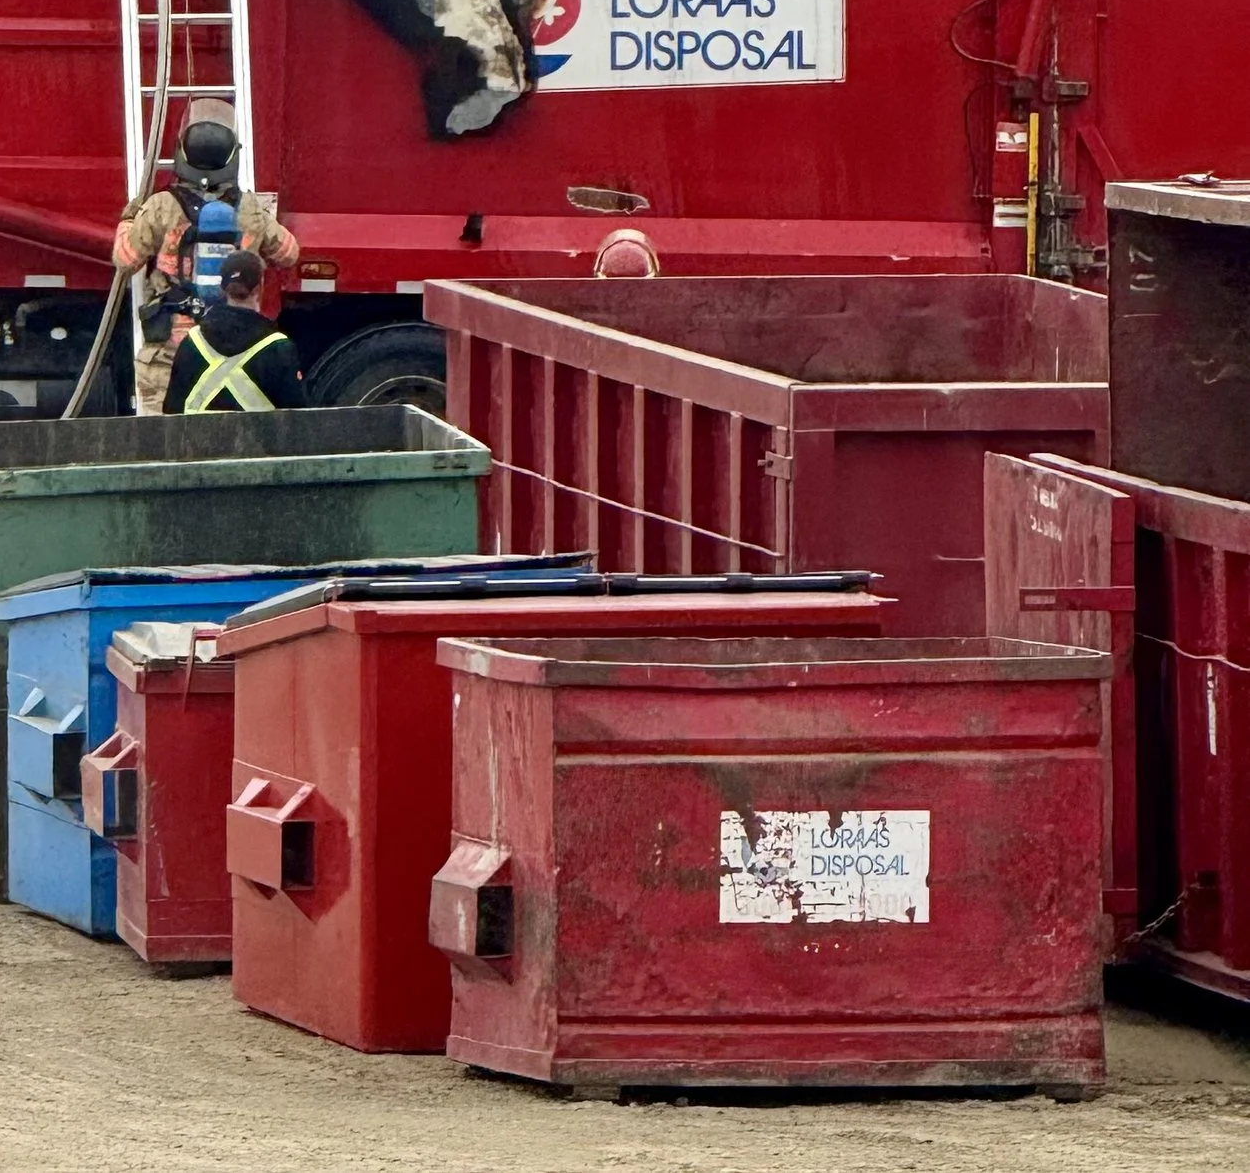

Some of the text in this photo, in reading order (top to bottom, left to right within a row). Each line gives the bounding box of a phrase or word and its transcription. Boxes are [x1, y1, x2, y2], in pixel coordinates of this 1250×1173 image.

[610, 29, 817, 71] DISPOSAL
[811, 827, 890, 849] LORAAS
[811, 854, 910, 877] DISPOSAL
